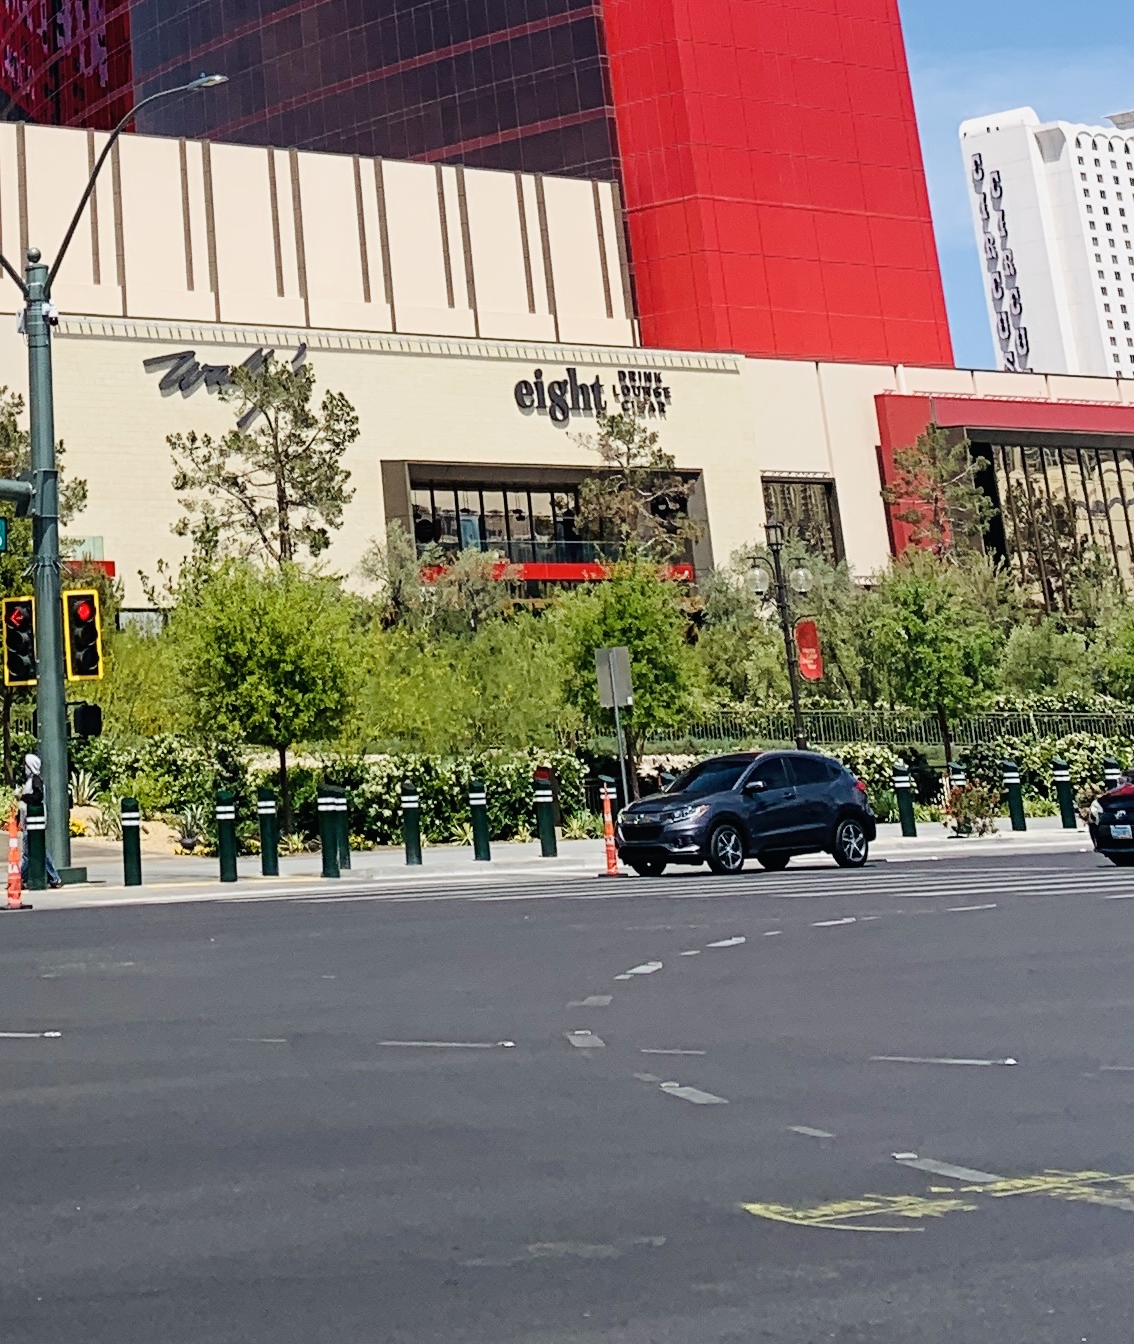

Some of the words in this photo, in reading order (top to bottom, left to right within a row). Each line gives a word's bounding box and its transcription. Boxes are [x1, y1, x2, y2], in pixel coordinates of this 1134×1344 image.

[989, 170, 1033, 373] CIRCU
[514, 367, 608, 422] eight
[612, 384, 672, 399] LOUNGE
[617, 370, 662, 384] DRINK
